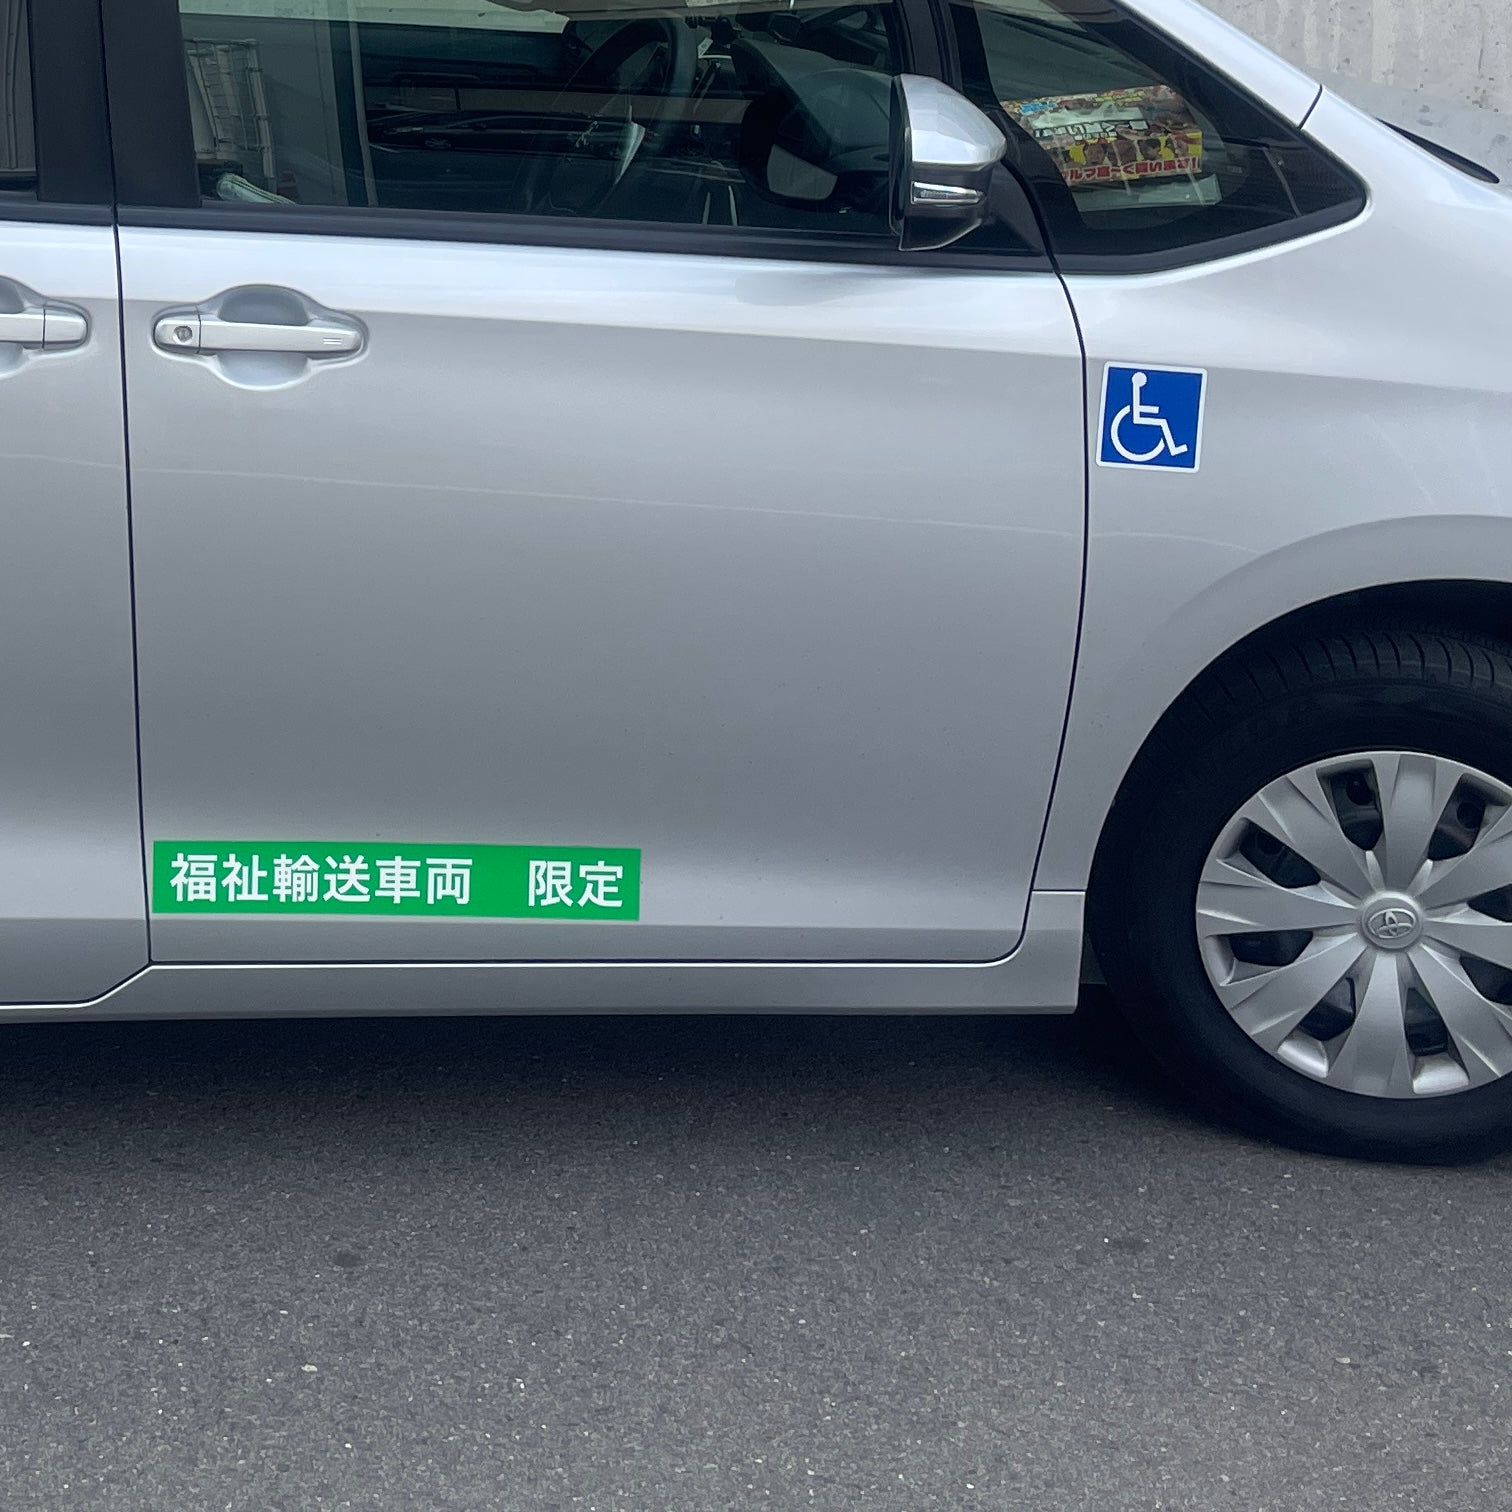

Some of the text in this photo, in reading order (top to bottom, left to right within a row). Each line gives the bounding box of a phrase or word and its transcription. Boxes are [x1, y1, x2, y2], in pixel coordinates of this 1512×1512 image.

[169, 852, 624, 908] 福祉輸送車両 限定
